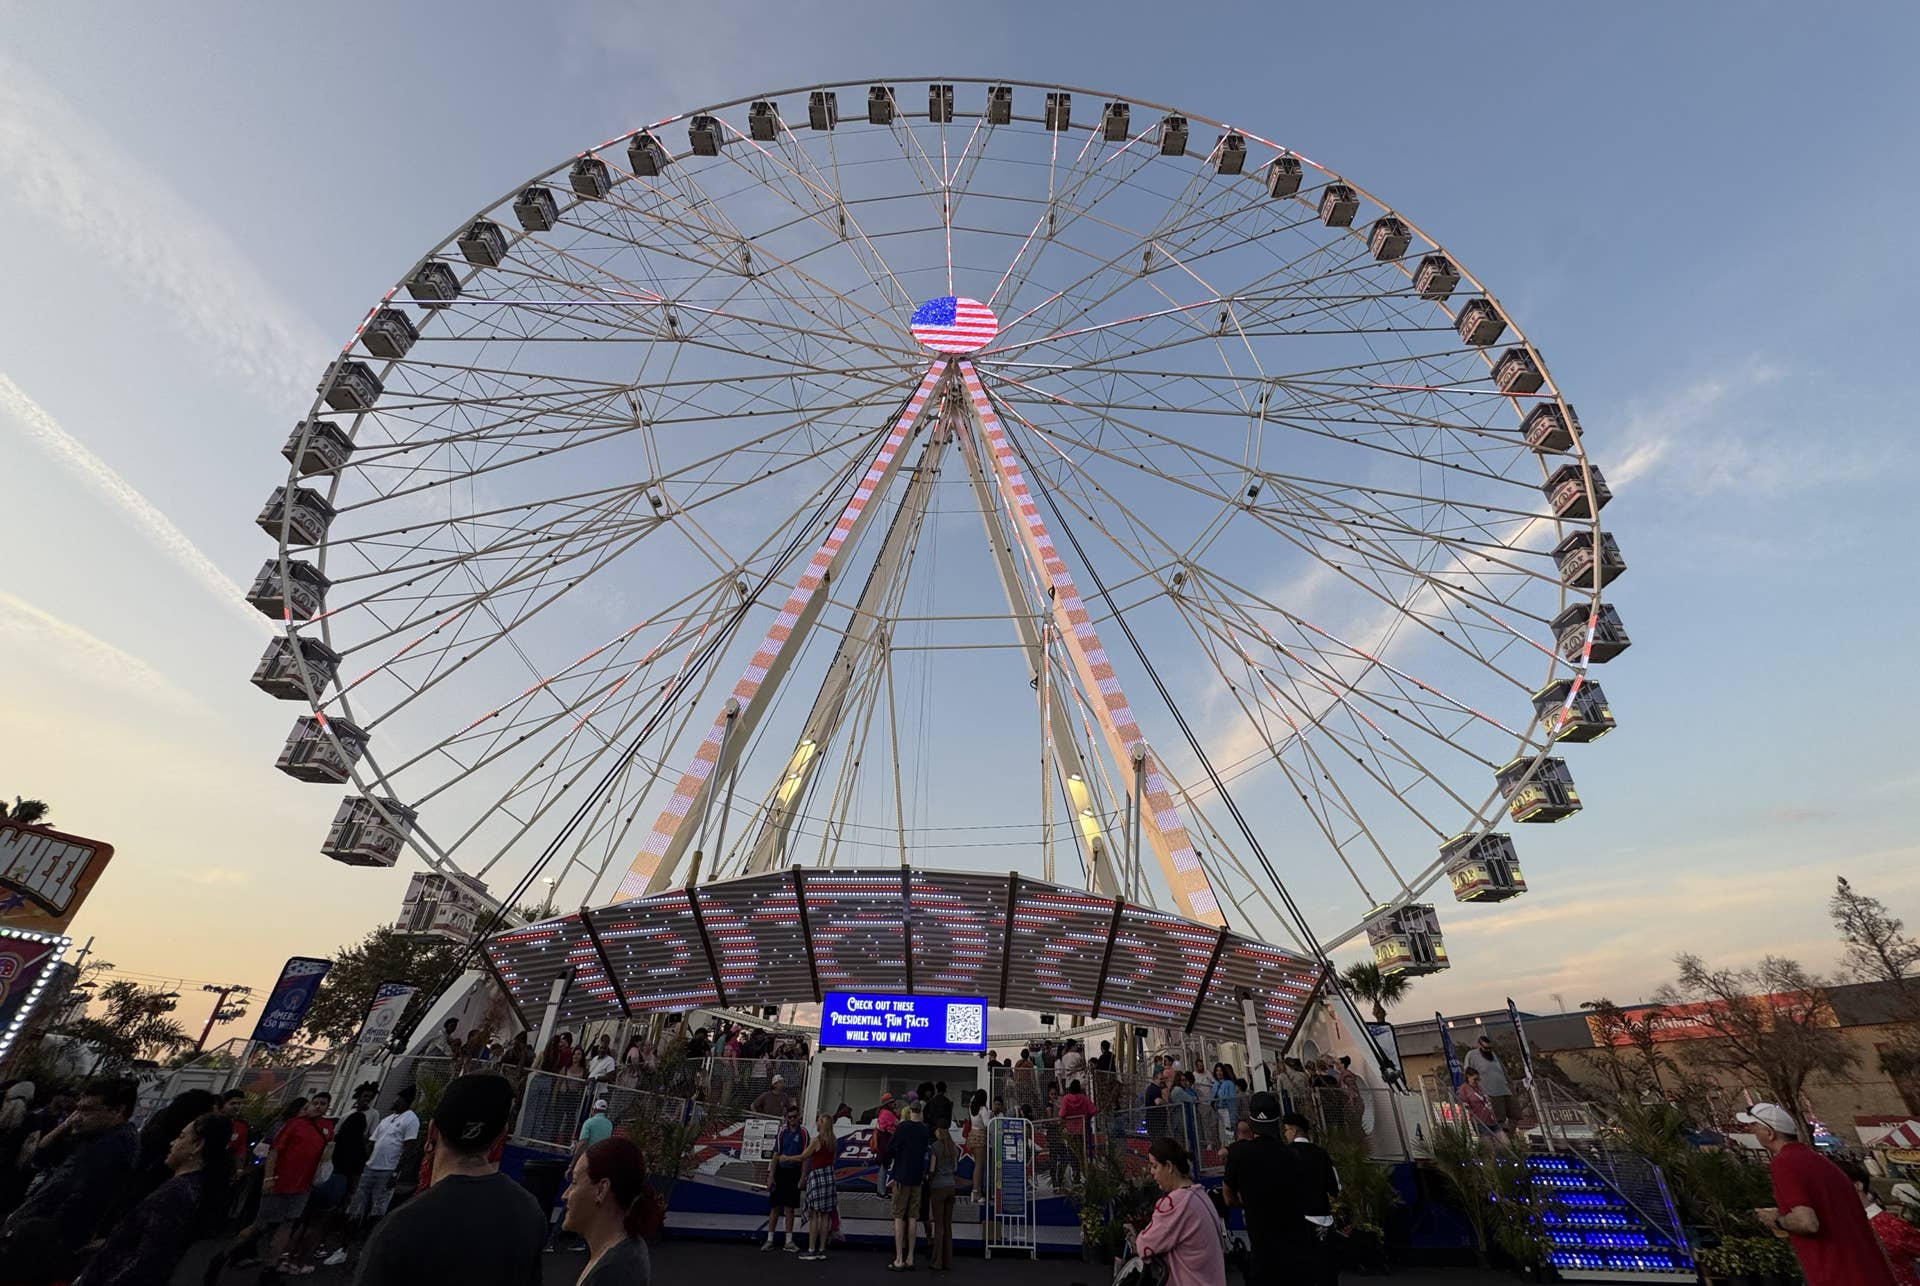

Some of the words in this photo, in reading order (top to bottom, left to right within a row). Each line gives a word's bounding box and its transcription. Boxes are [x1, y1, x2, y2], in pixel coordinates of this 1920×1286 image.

[0, 828, 92, 909] WHEEL
[847, 996, 872, 1012] CHECK
[875, 1001, 890, 1011] OUT
[893, 1001, 914, 1012] THESE
[830, 1011, 882, 1026] PRESIDENTIAL
[884, 1012, 902, 1028] FUN
[904, 1013, 929, 1029] FACTS
[846, 1031, 869, 1041] WHILE
[871, 1031, 887, 1042] YOU
[889, 1032, 911, 1043] WAIT!
[840, 1145, 878, 1160] 25
